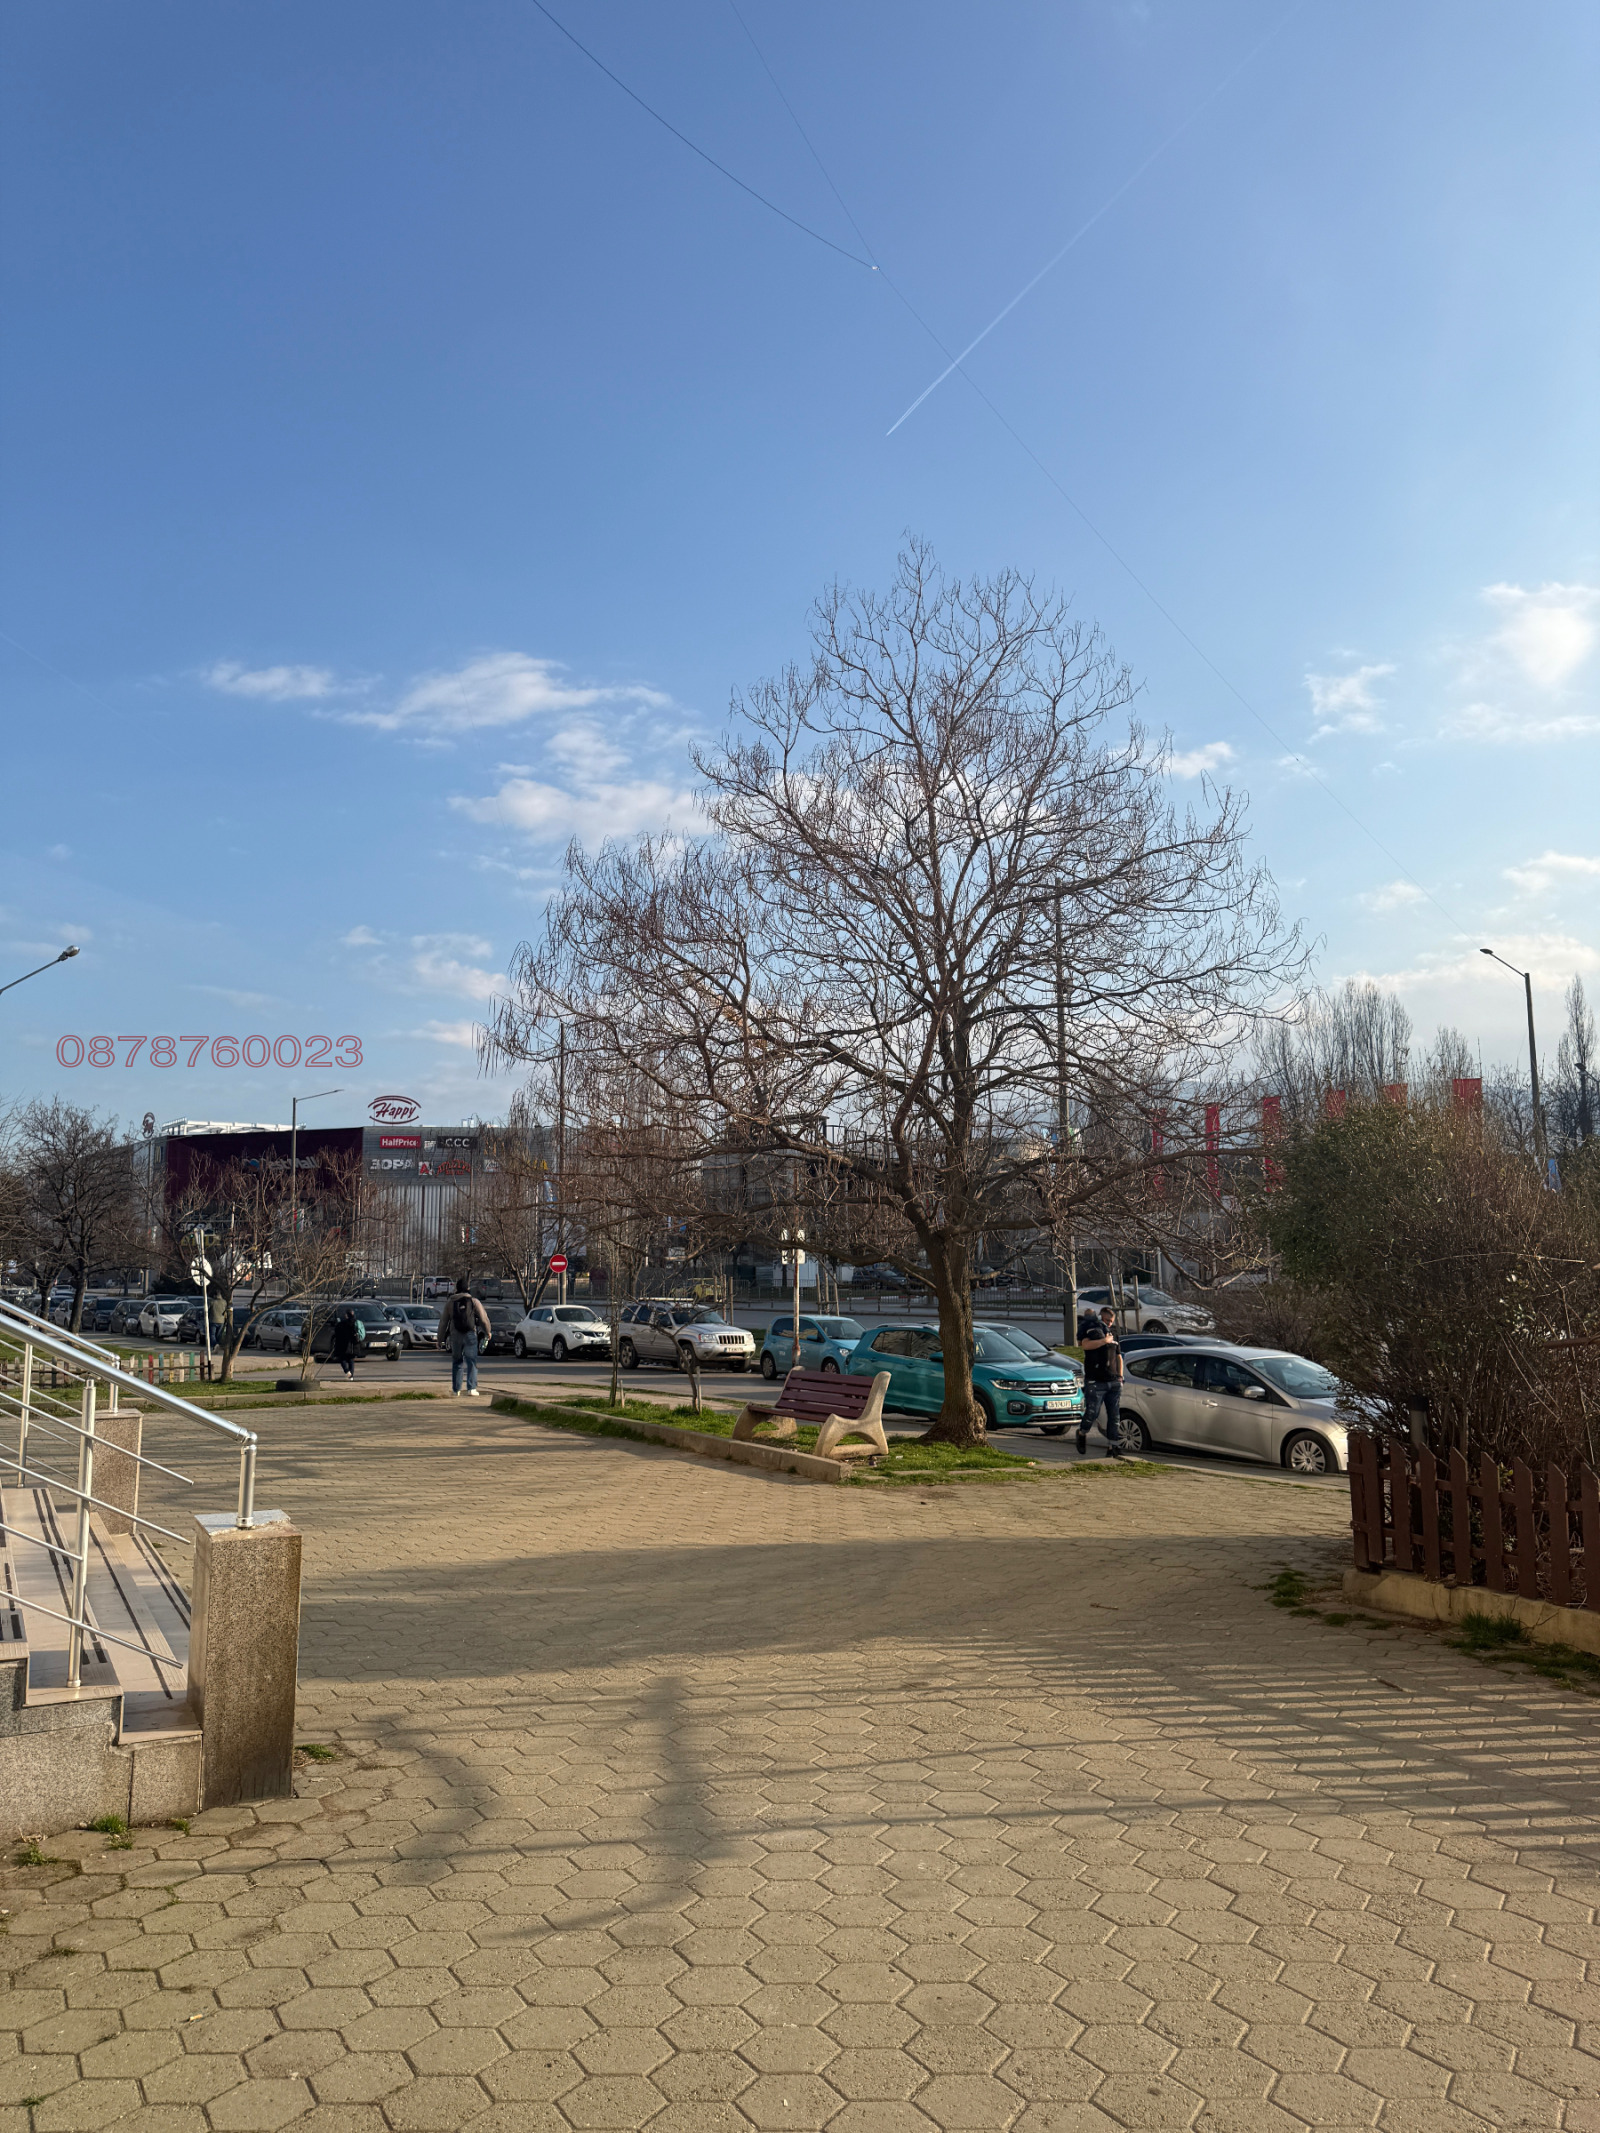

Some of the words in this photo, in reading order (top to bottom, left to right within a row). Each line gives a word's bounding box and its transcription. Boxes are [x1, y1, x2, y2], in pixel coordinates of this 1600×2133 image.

[373, 1102, 416, 1119] Happy
[381, 1138, 417, 1147] HalfPrice
[445, 1138, 470, 1147] CCC
